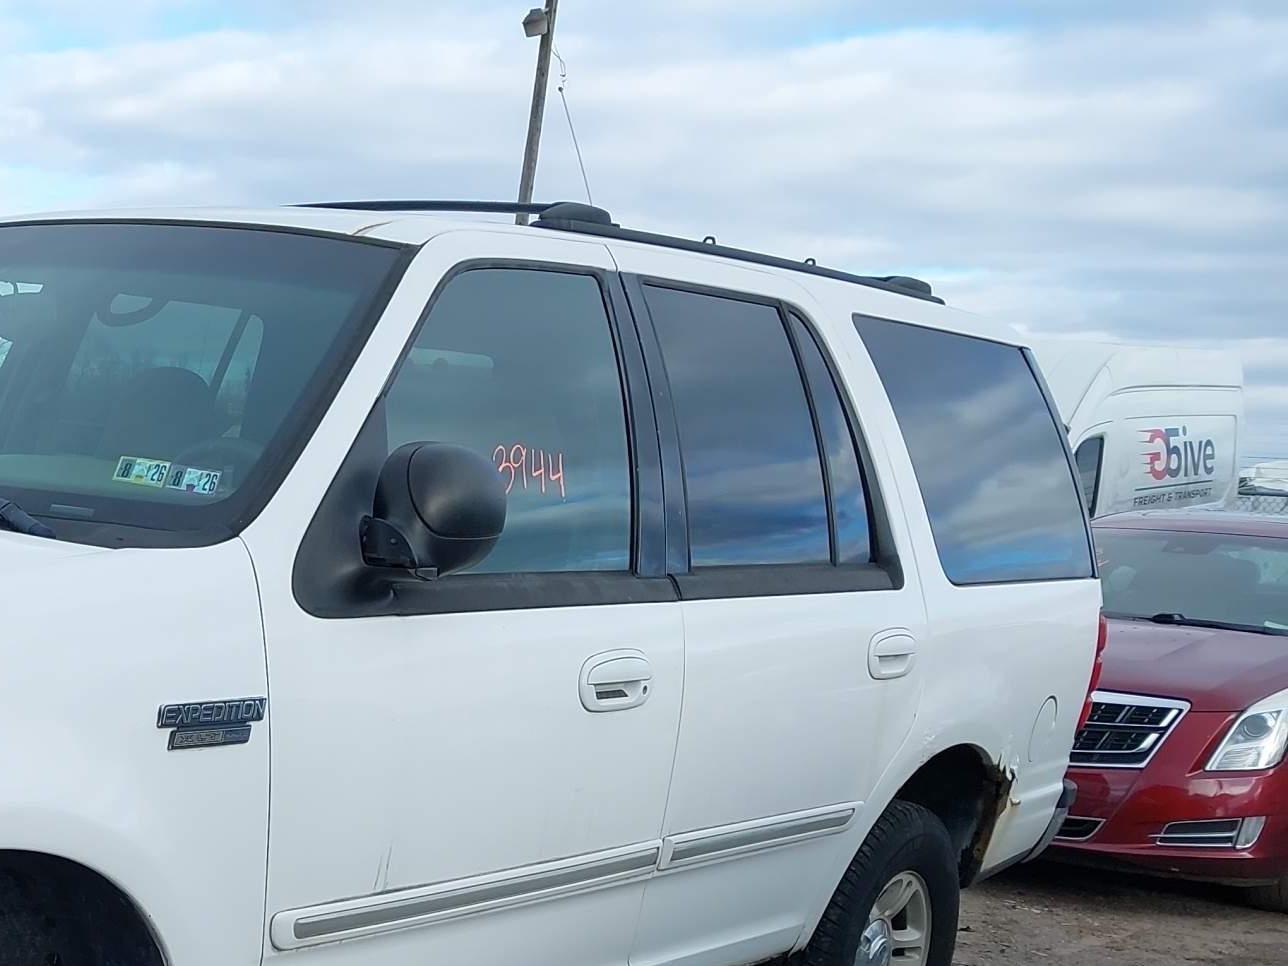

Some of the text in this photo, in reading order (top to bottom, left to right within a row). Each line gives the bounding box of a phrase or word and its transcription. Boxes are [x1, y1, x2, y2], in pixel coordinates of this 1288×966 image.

[120, 462, 132, 479] 8
[172, 470, 184, 487] 8
[493, 444, 565, 497] 3944
[1133, 493, 1166, 507] FREIGHT
[1175, 487, 1213, 500] TRANSPORT
[161, 700, 267, 725] EXPEDITION
